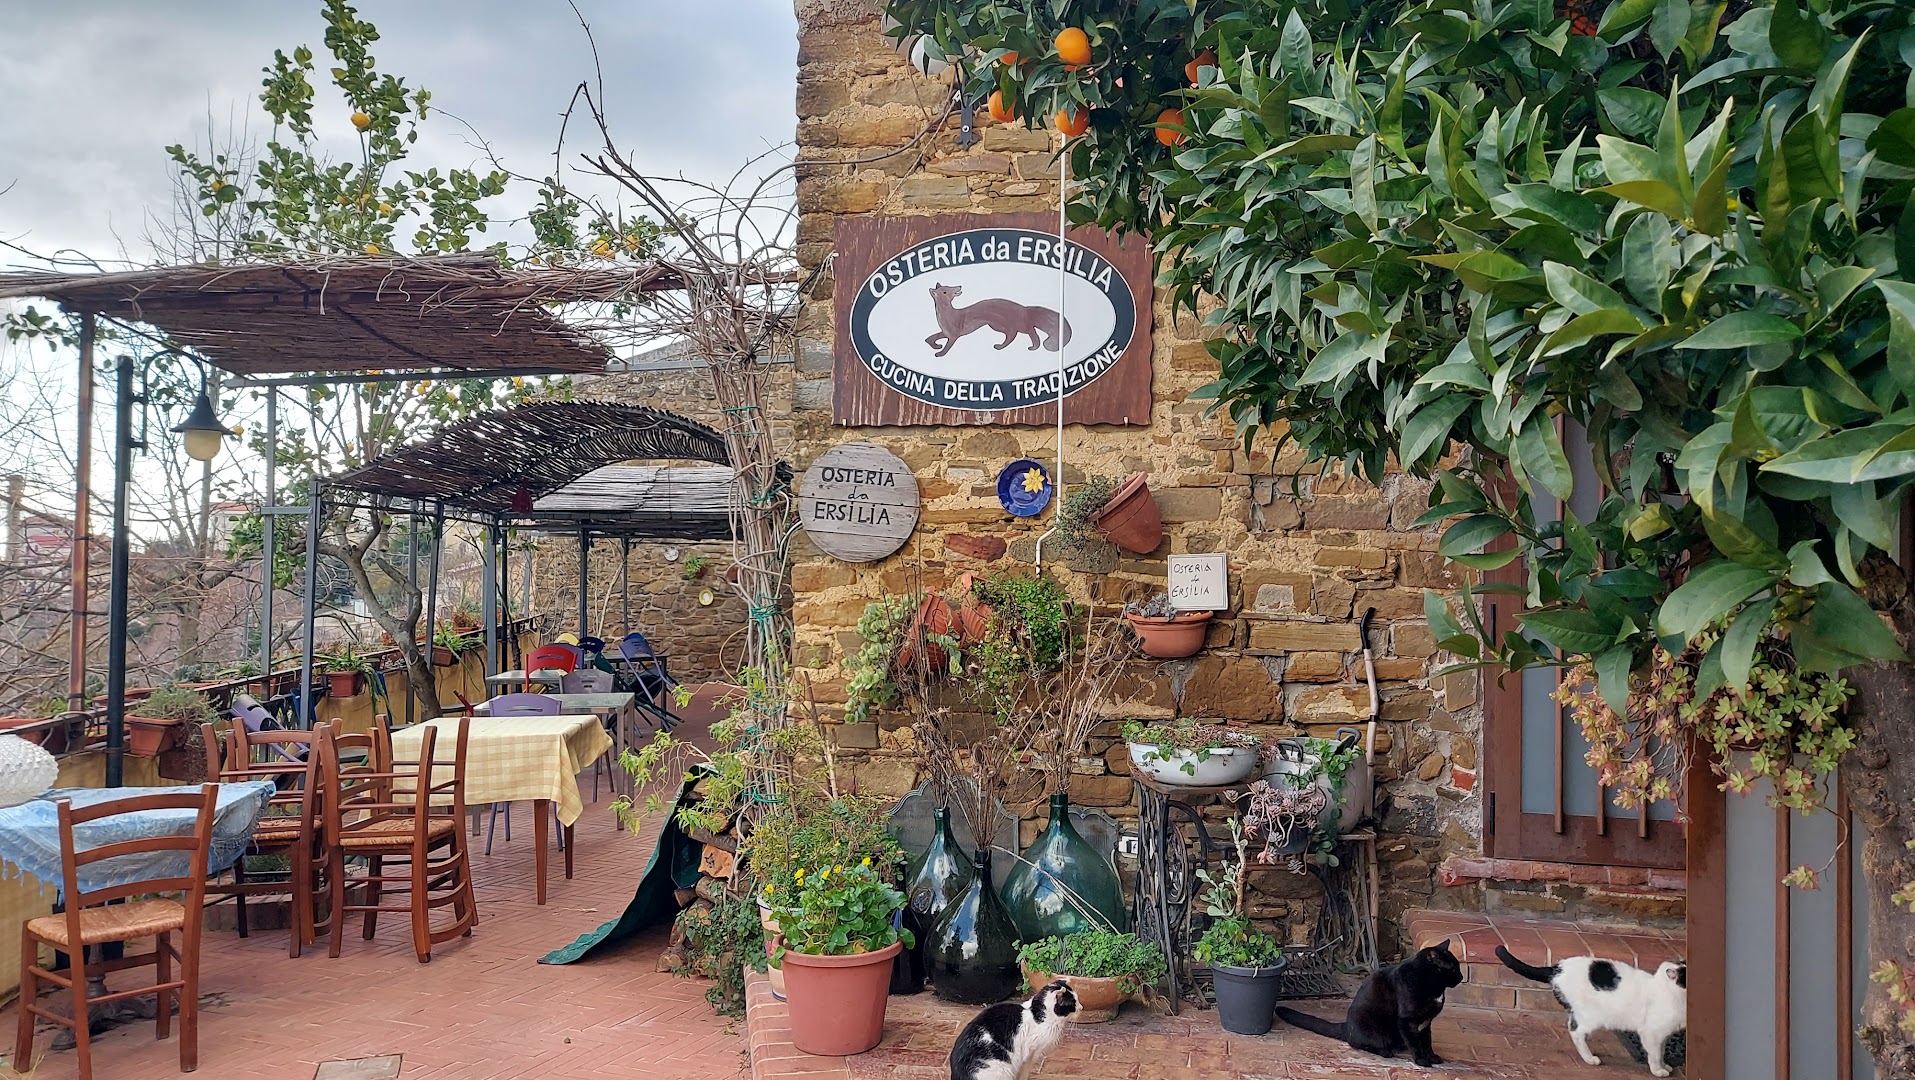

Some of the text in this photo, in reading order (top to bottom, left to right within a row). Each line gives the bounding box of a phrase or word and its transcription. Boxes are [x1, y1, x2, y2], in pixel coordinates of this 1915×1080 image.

[869, 235, 1114, 299] OSTERIA da ERSILIA
[870, 339, 1123, 402] CUCINA DELLA TRADIZIONE
[847, 485, 869, 500] da
